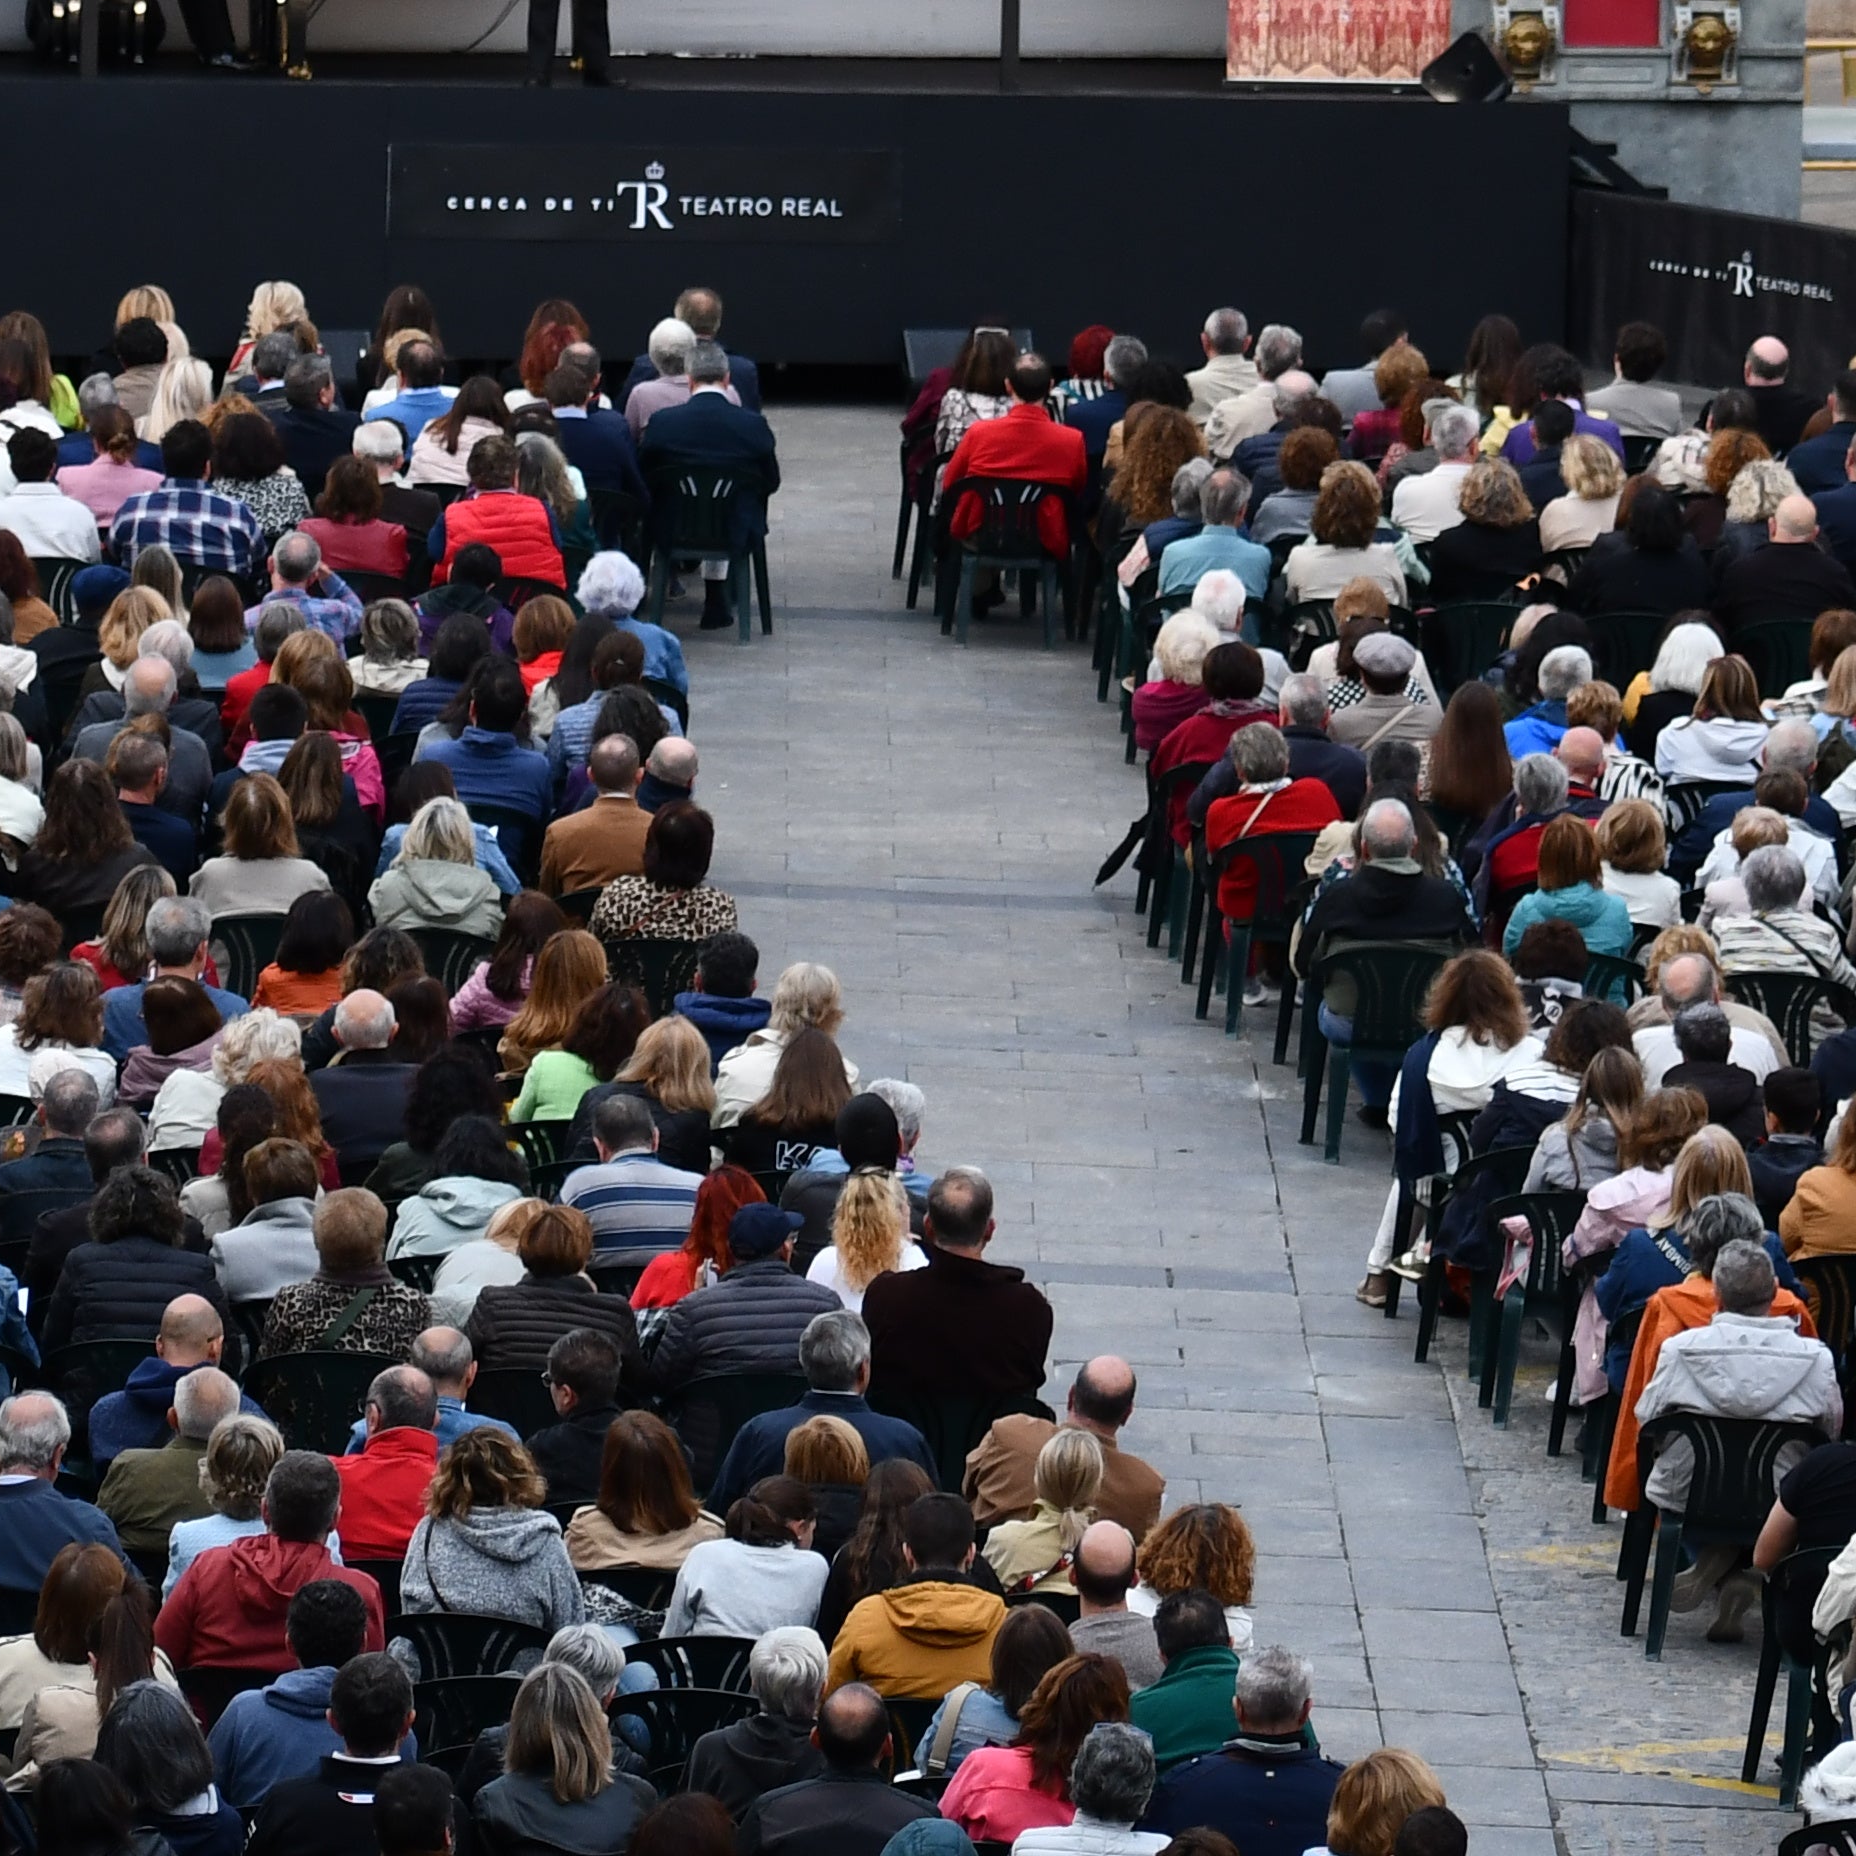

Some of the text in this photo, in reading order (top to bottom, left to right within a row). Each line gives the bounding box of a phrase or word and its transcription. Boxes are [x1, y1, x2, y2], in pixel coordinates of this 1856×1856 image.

[446, 196, 528, 212] CERCA
[544, 197, 575, 212] DE
[590, 197, 615, 212] TI
[678, 196, 773, 218] TEATRO
[781, 197, 844, 218] REAL
[1755, 275, 1801, 296] TEATRO
[1802, 283, 1834, 302] REAL
